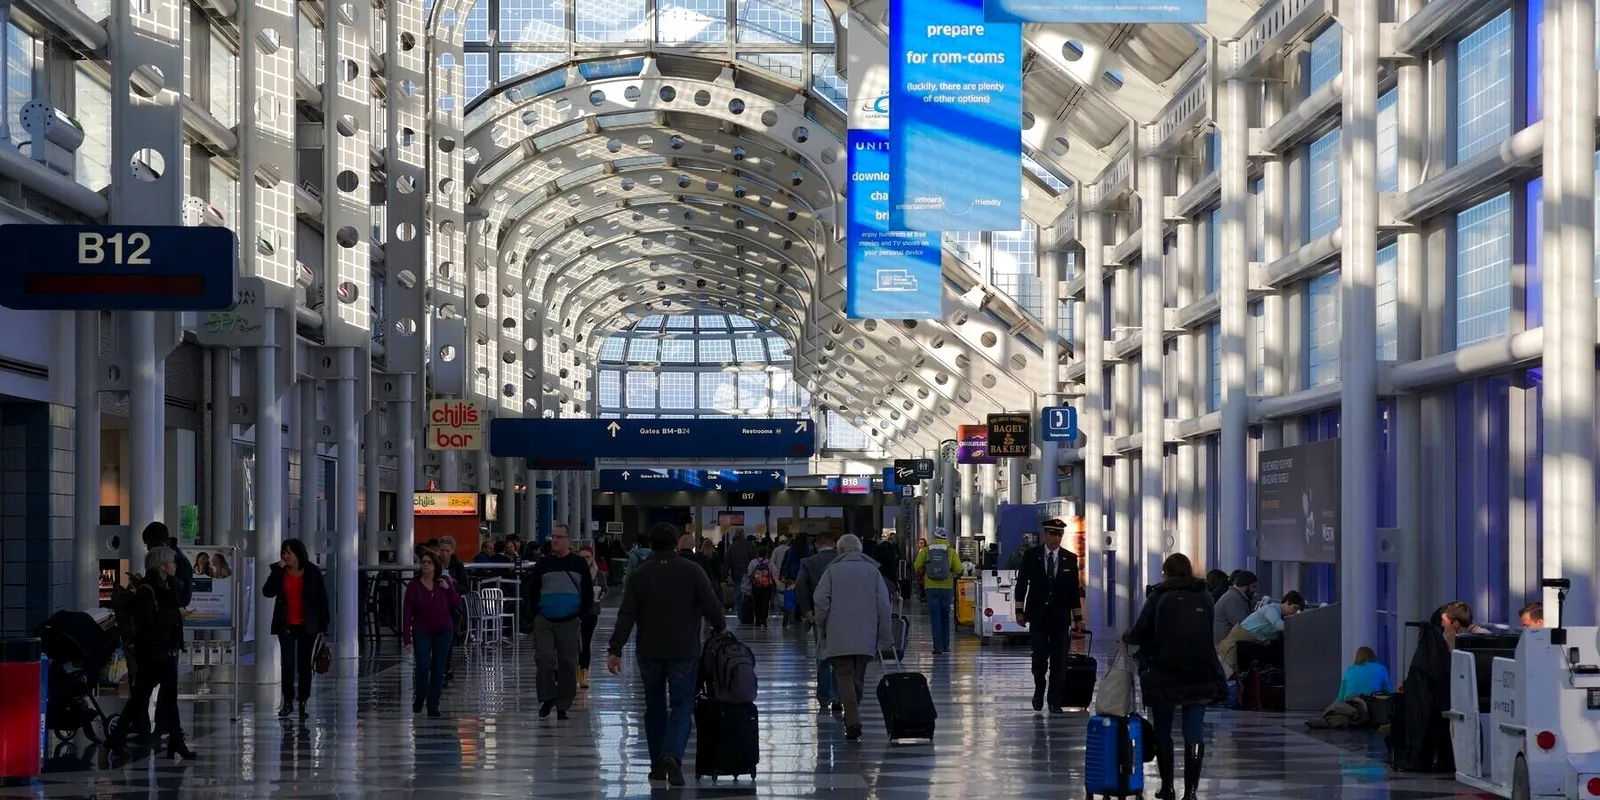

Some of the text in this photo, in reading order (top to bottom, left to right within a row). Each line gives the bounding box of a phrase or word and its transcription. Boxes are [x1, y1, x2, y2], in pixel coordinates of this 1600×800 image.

[927, 24, 985, 38] prepare
[906, 51, 1005, 63] for rom-coms
[907, 82, 938, 92] (luckily,
[939, 82, 961, 91] there
[978, 82, 1004, 92] plenty
[923, 94, 990, 104] of other options)
[852, 172, 889, 181] downlo
[870, 191, 889, 200] cha
[974, 198, 1001, 207] friendly
[875, 211, 889, 220] bri
[862, 231, 878, 239] enjoy
[879, 230, 906, 238] hundreds
[78, 232, 152, 265] B12
[432, 402, 478, 428] chili's
[640, 427, 660, 435] Gates
[993, 425, 1024, 433] BAGEL
[437, 428, 473, 448] bar
[990, 445, 1028, 453] BAKERY
[842, 478, 858, 486] B18
